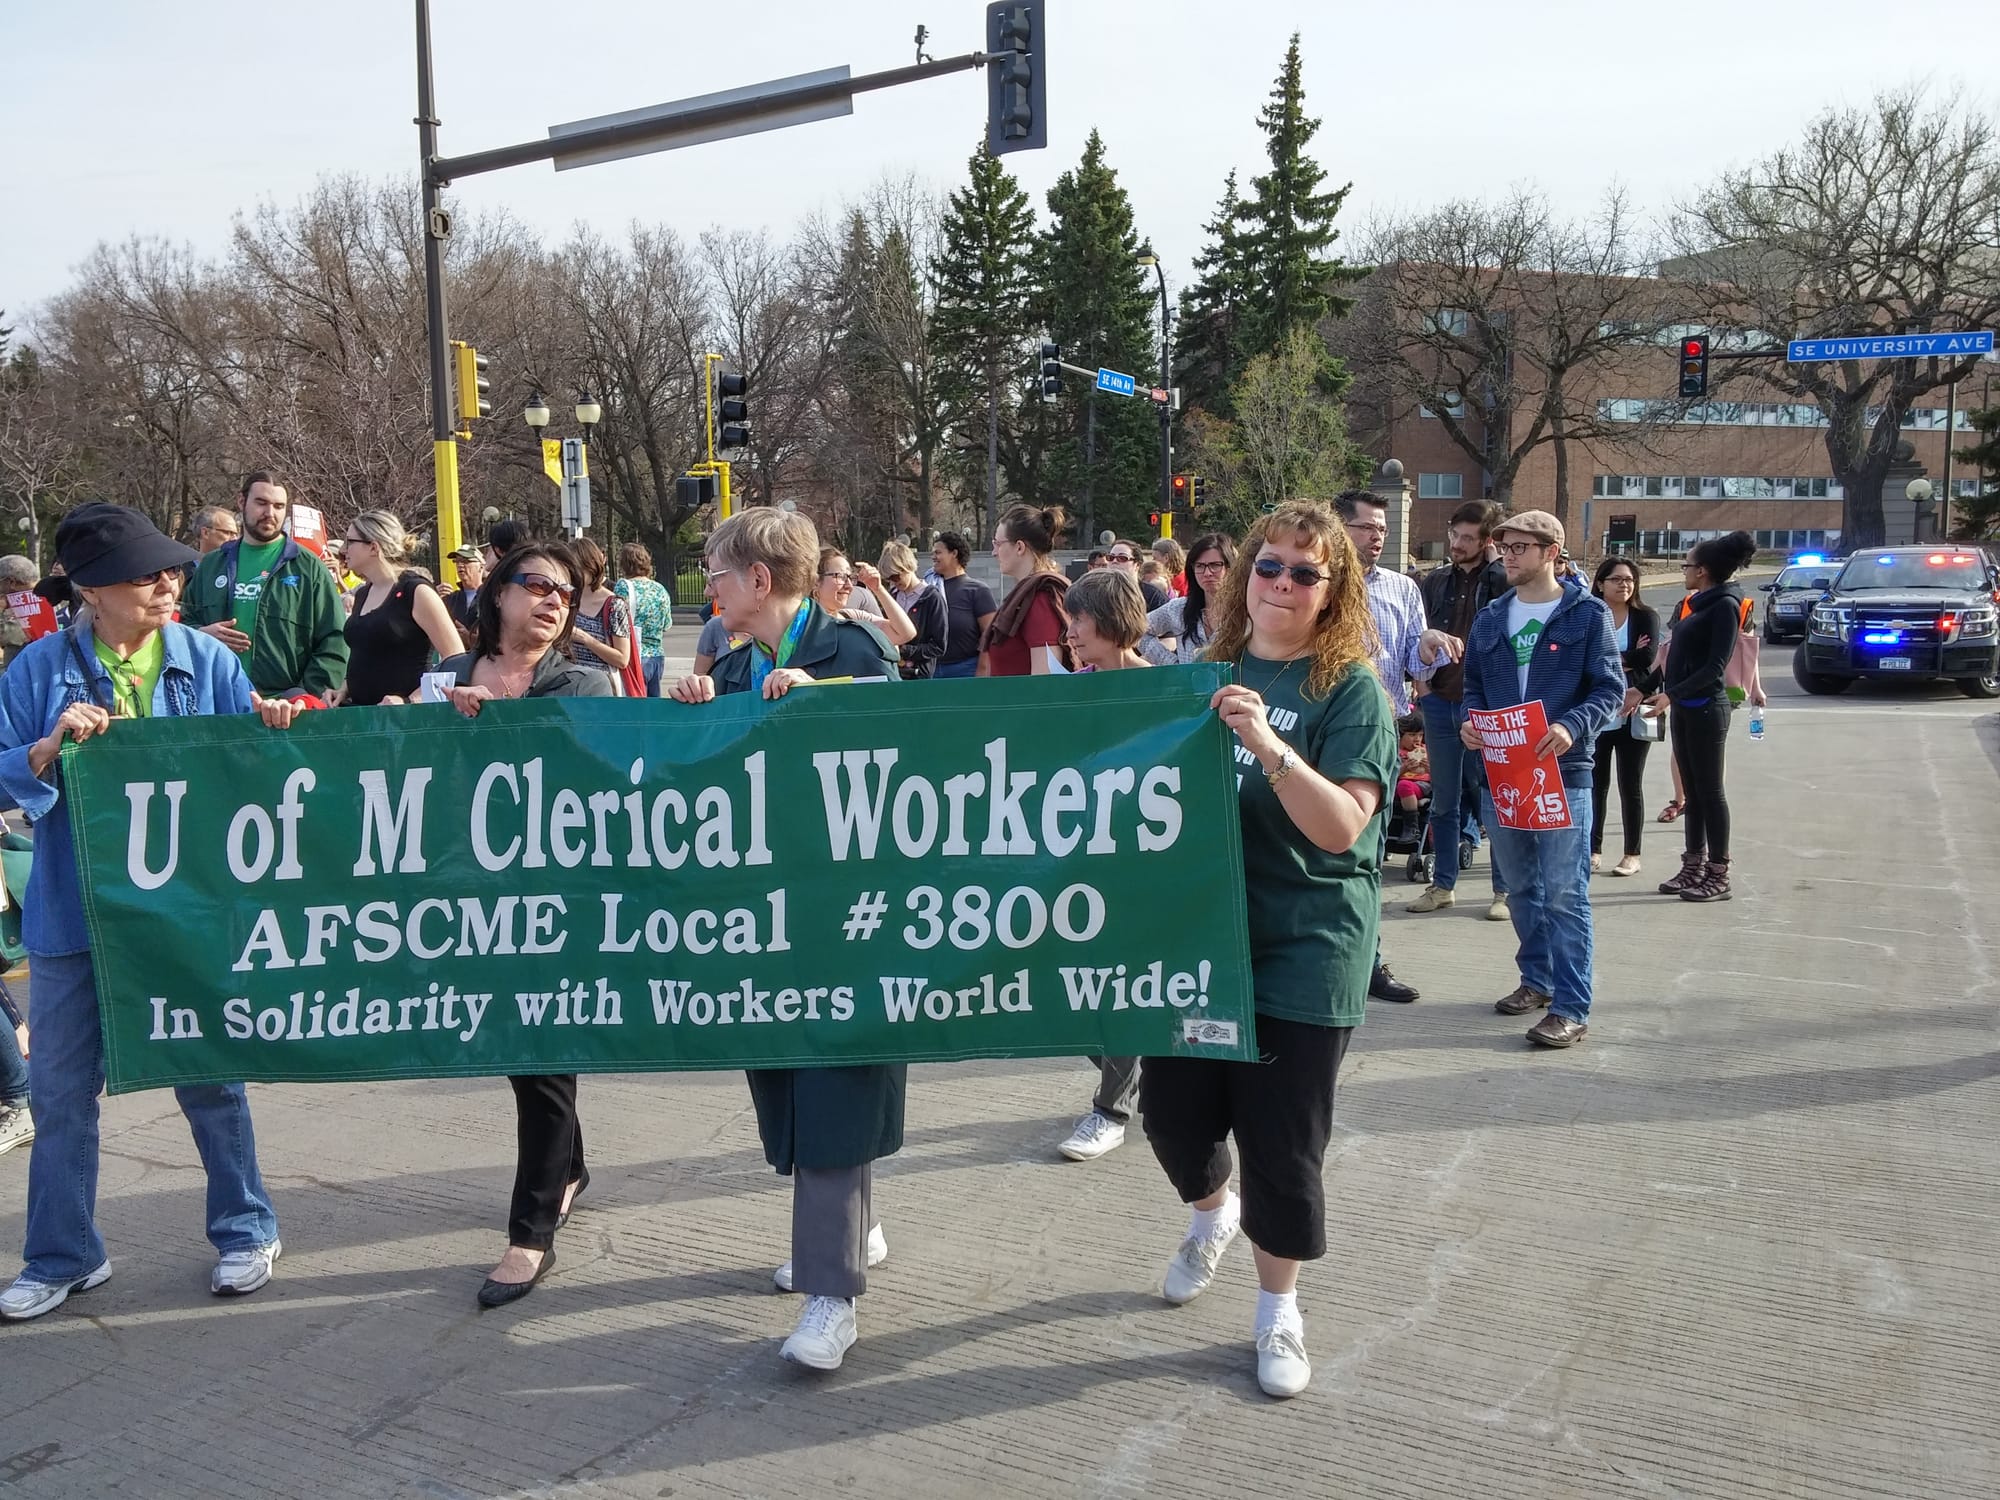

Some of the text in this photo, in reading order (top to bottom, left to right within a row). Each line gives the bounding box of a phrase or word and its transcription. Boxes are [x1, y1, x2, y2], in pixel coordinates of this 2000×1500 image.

[1794, 336, 1987, 357] SE UNIVERSITY AVE
[1472, 709, 1529, 730] RAISE THE
[1484, 746, 1510, 764] WAGE
[126, 737, 1183, 890] U of M Clerical Workers
[1534, 792, 1563, 814] 15
[1538, 812, 1565, 824] NOW
[231, 894, 568, 972] AFSCME
[598, 888, 791, 954] Local
[149, 960, 1212, 1042] In Solidarity with Workers World Wide!
